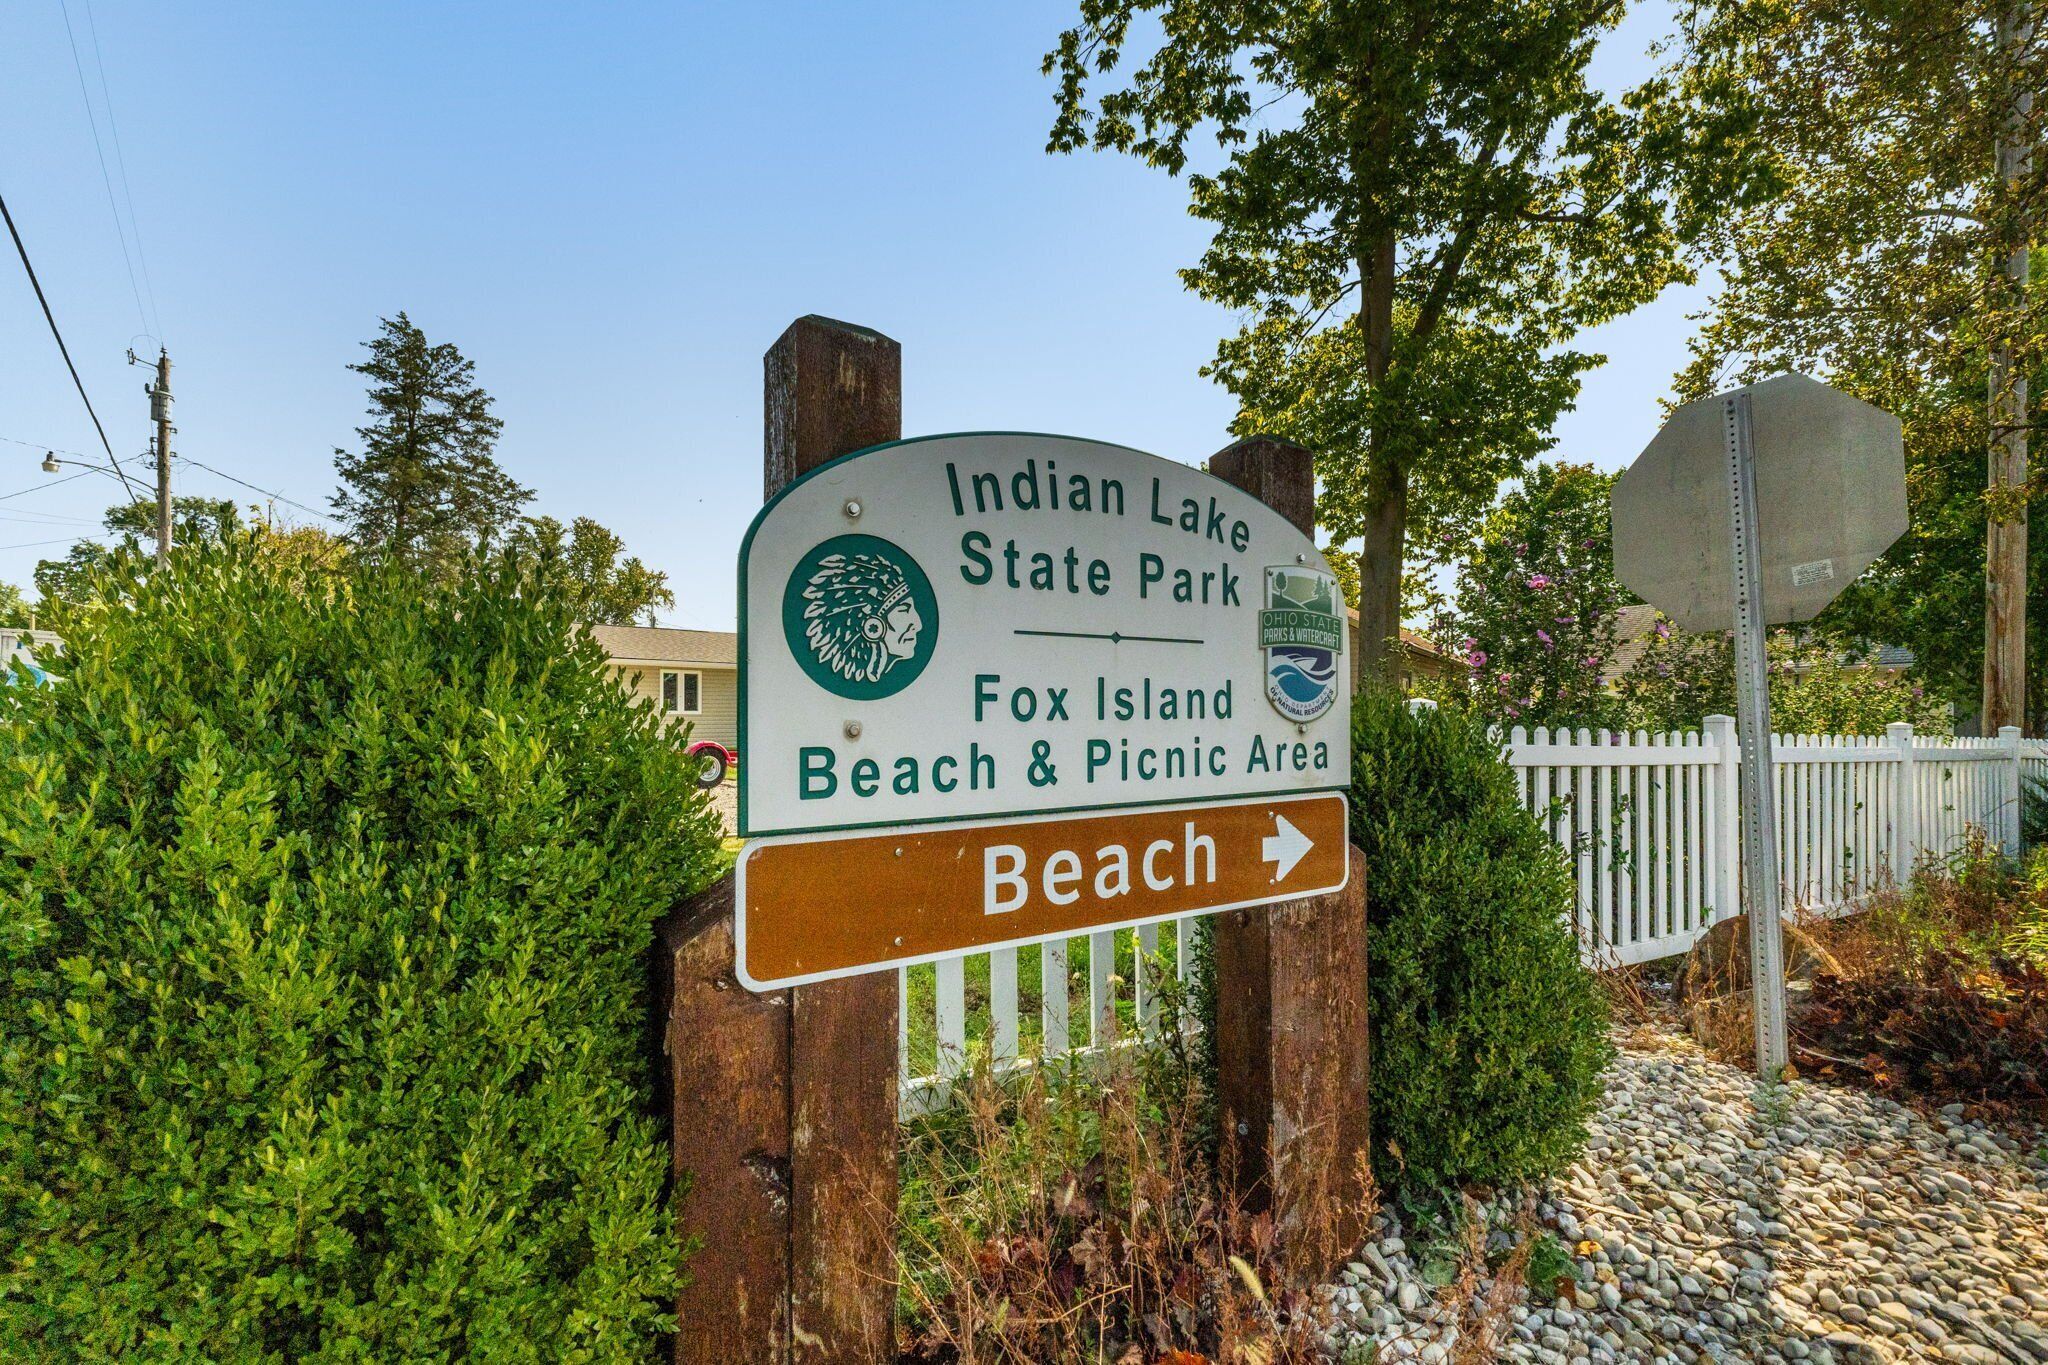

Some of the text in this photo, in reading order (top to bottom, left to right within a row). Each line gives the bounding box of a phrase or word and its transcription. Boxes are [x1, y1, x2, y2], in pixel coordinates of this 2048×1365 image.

[946, 459, 1250, 553] Indian Lake
[960, 531, 1241, 607] State Park
[1264, 612, 1339, 633] OHIO STATE
[1264, 628, 1339, 648] PARKS & WATERCRAFT
[975, 674, 1233, 721] Fox Island
[1270, 687, 1334, 716] OF NATURAL RESOURCES
[800, 734, 1329, 800] Beach & Picnic Area
[984, 822, 1216, 915] Beach
